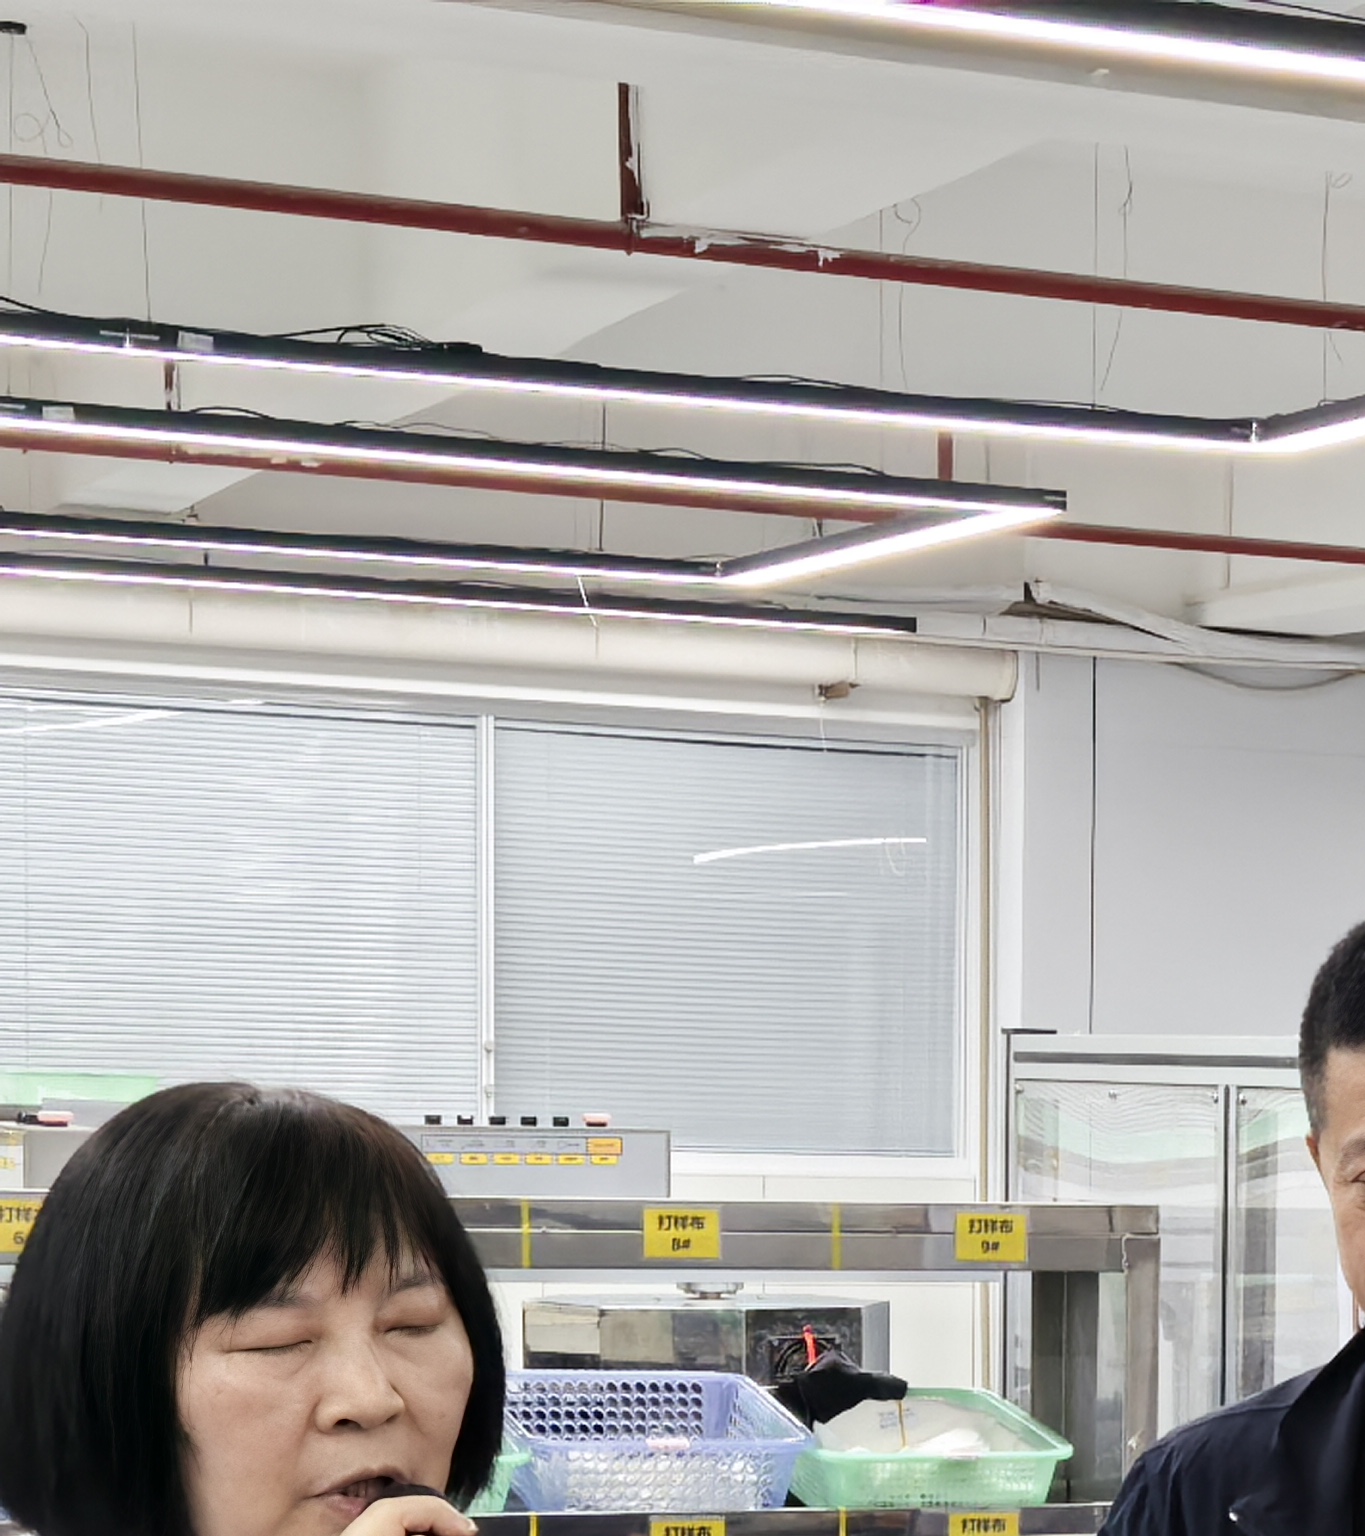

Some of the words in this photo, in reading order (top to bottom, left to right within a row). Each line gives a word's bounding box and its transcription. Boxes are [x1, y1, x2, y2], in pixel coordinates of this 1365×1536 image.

[658, 1214, 706, 1231] 打样布
[969, 1217, 1014, 1234] 打样布
[981, 1240, 1000, 1254] 9#
[961, 1517, 1006, 1534] 打样布
